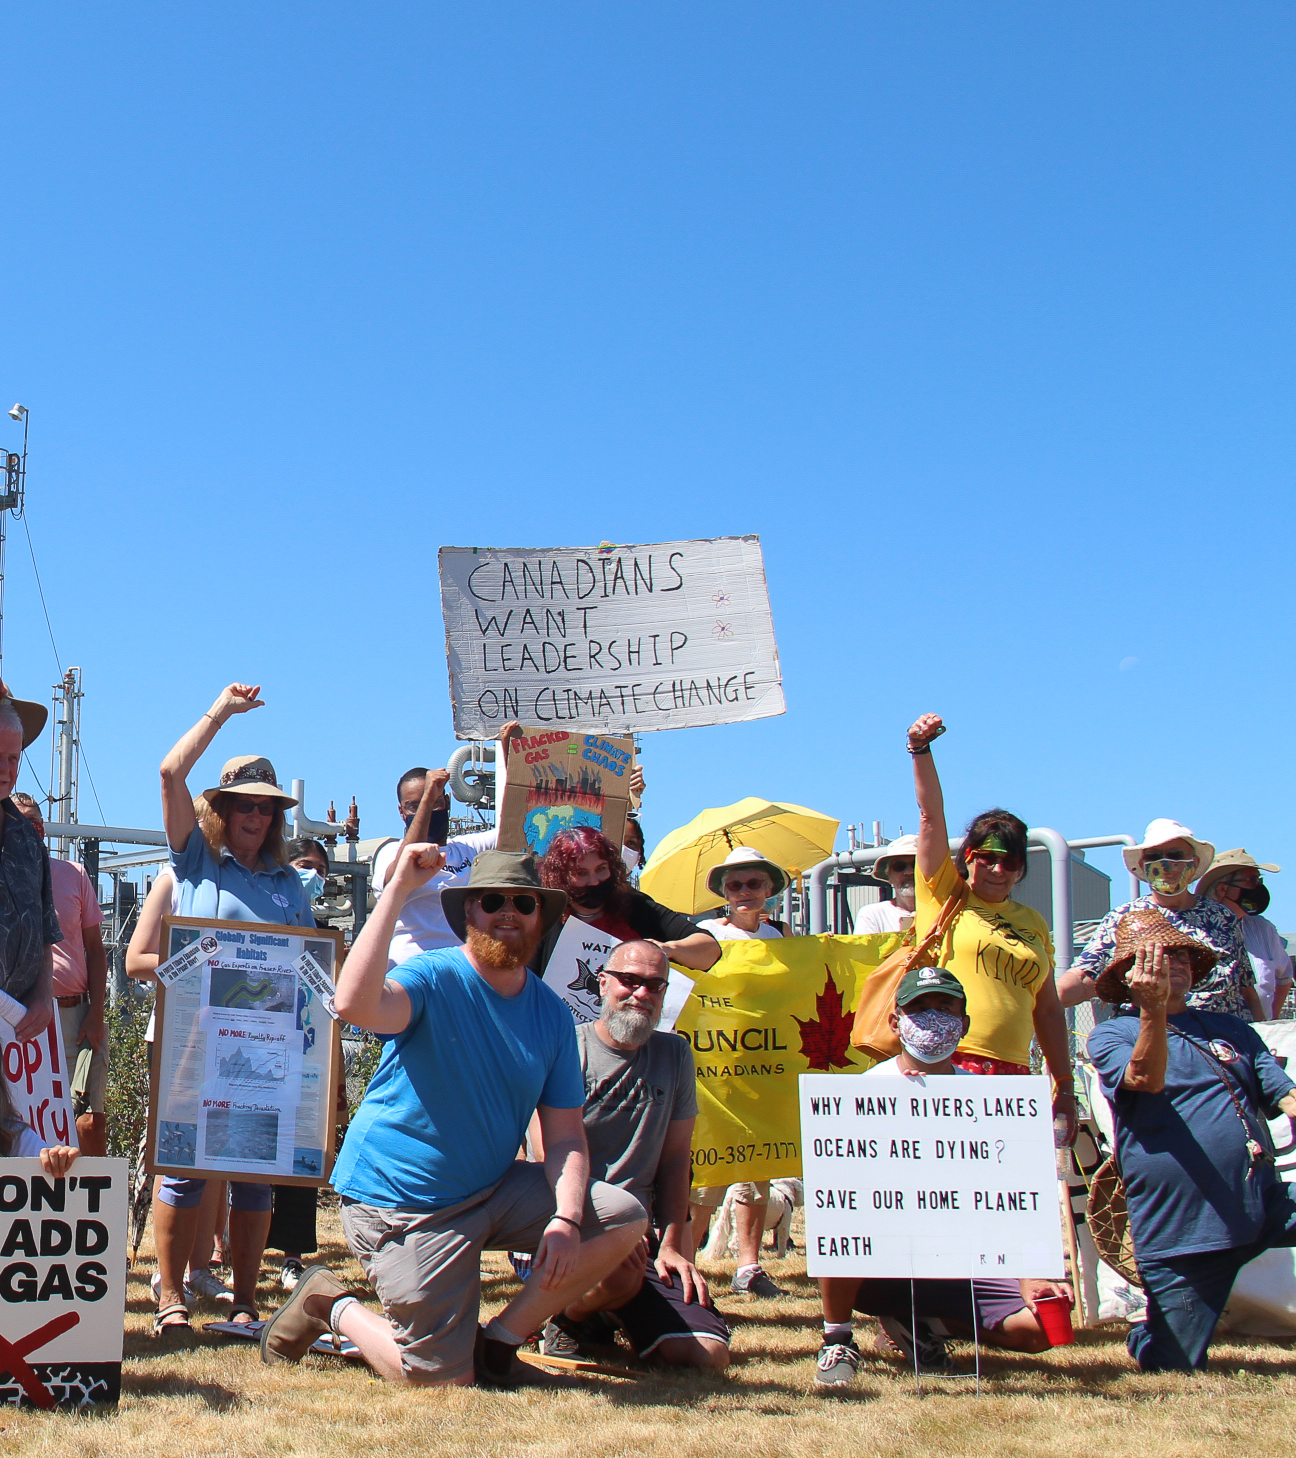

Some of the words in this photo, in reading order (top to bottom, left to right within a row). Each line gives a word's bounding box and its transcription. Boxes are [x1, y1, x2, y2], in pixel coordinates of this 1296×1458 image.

[468, 551, 684, 602] CANADIANS
[474, 606, 598, 638] WANT
[482, 631, 688, 674] LEADERSHIP
[477, 686, 520, 719] ON
[534, 683, 642, 721] CLIMATE
[653, 671, 756, 711] CHANGE
[511, 731, 570, 754] FRACKED
[584, 734, 632, 765] CLIMATE
[525, 748, 550, 764] GAS
[582, 748, 626, 777] CHAOS
[215, 930, 245, 944] Globally
[249, 933, 289, 947] Significant
[236, 947, 267, 961] Habitats
[975, 939, 1040, 989] KIND
[232, 962, 250, 970] Exports
[258, 963, 276, 972] Fraser
[277, 965, 294, 973] River
[697, 994, 734, 1008] THE
[218, 1028, 229, 1037] NO
[230, 1029, 246, 1038] MORE
[202, 1099, 212, 1107] NO
[232, 1102, 253, 1111] Fracking
[253, 1104, 282, 1112] Devastation
[810, 1097, 842, 1116] WHY
[855, 1097, 897, 1116] MANY
[911, 1098, 978, 1122] RIVERS,
[984, 1098, 1038, 1117] LAKES
[813, 1138, 878, 1159] OCEANS
[889, 1139, 922, 1159] ARE
[935, 1139, 1005, 1163] DYING?
[815, 1190, 857, 1210] SAVE
[872, 1190, 904, 1210] OUR
[917, 1190, 960, 1210] HOME
[974, 1191, 1039, 1211] PLANET
[0, 1218, 109, 1257] ADD
[817, 1236, 872, 1256] EARTH
[998, 1254, 1005, 1265] N
